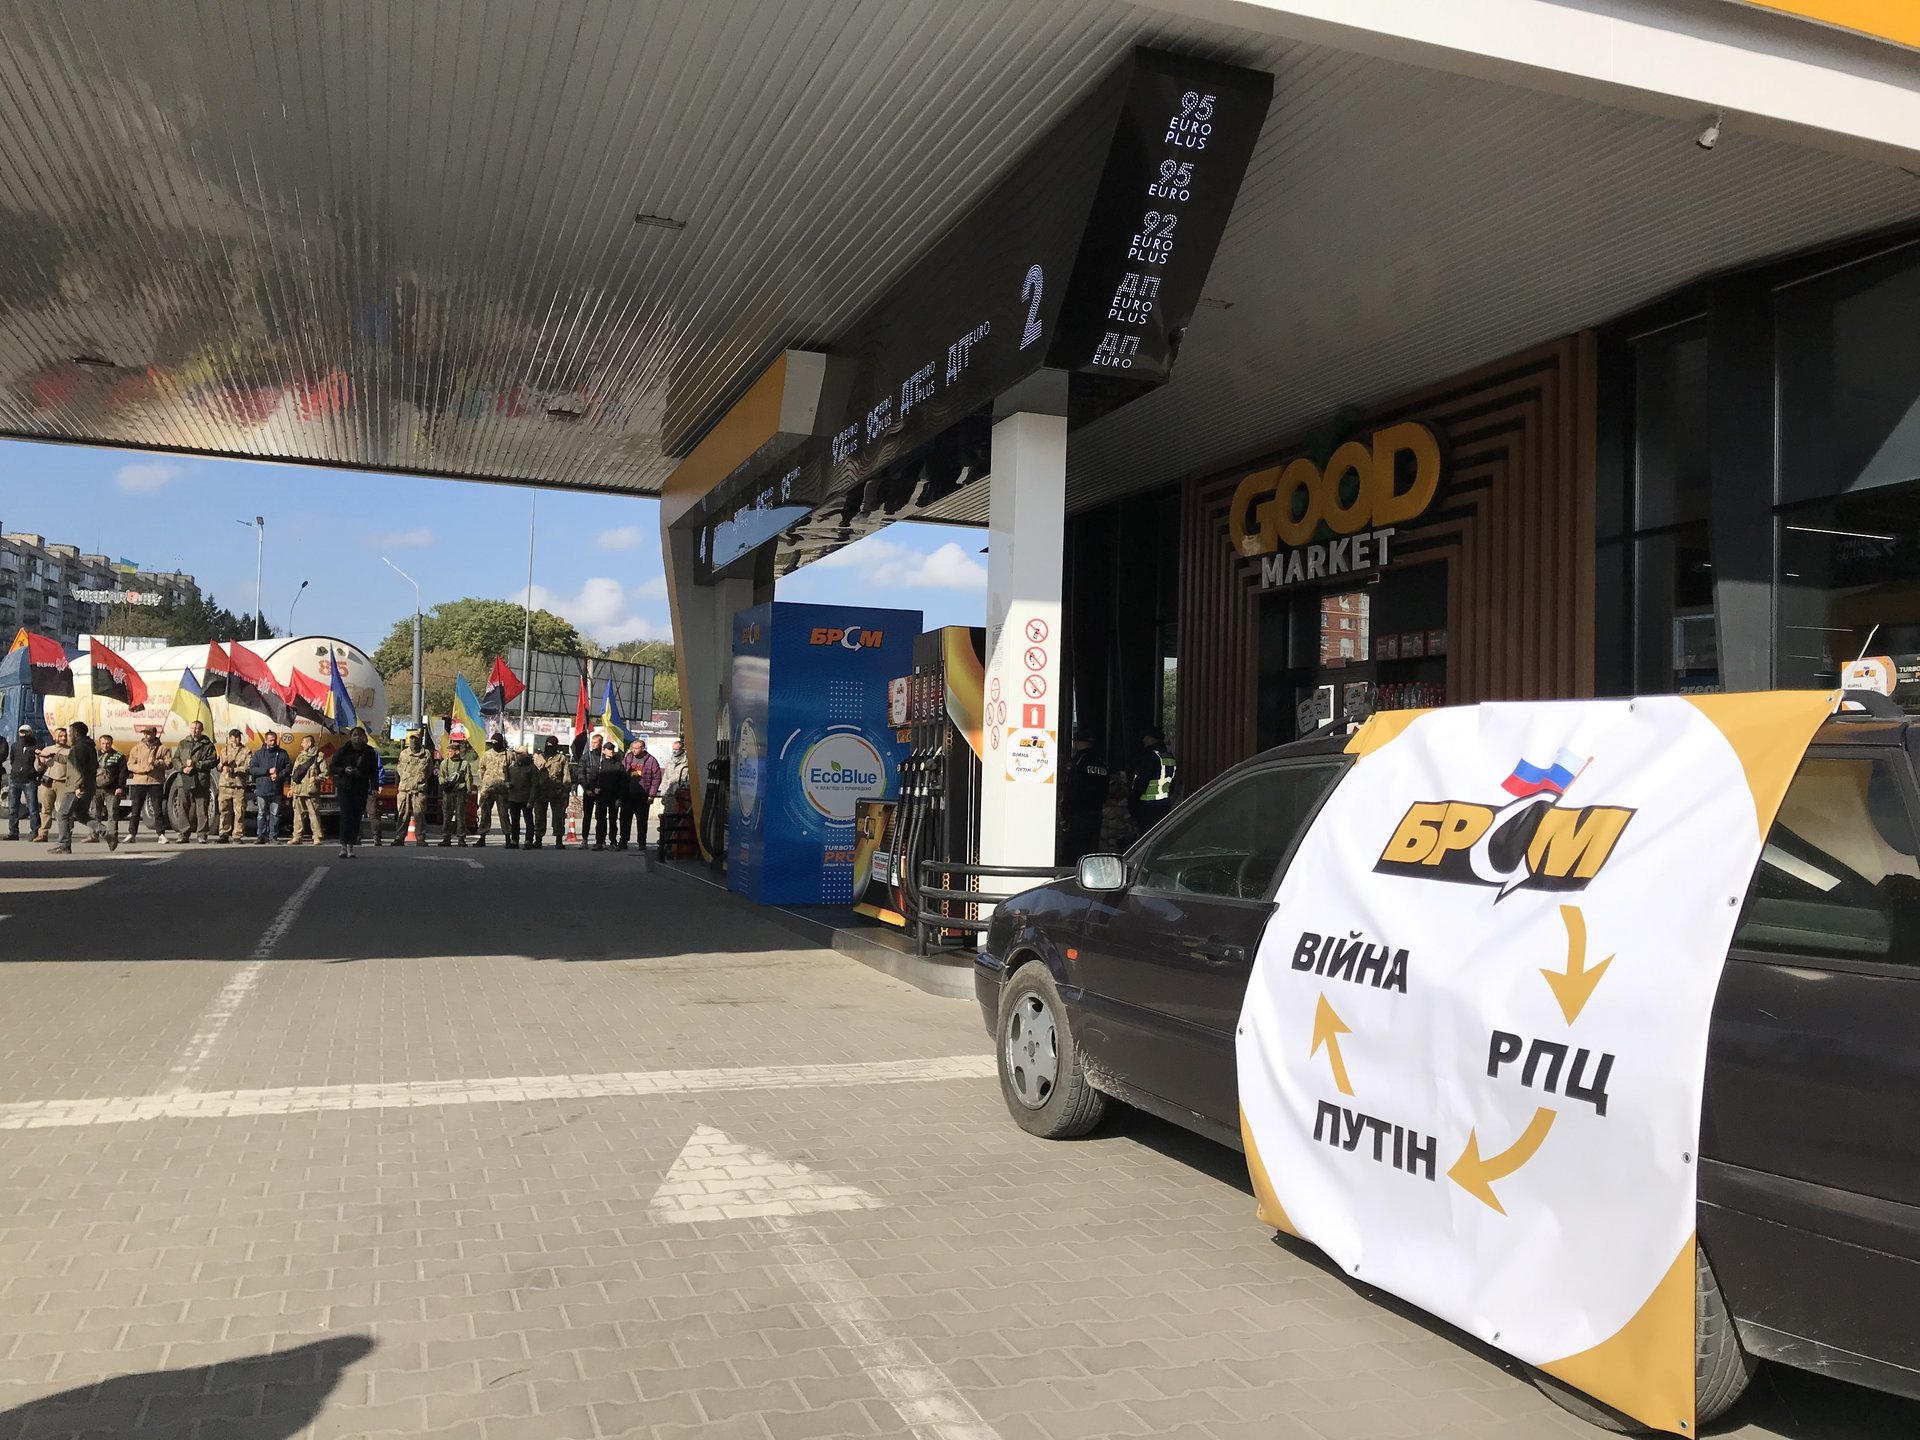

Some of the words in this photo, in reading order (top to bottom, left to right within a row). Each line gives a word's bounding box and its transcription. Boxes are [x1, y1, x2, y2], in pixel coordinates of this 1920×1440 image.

[1180, 90, 1217, 121] 95
[1169, 116, 1212, 136] EURO
[1165, 131, 1206, 150] PLUS
[1158, 158, 1195, 188] 95
[1148, 183, 1190, 202] EURO
[1143, 210, 1178, 239] 92
[1132, 234, 1173, 252] EURO
[1127, 247, 1168, 265] PLUS
[1115, 272, 1162, 299] ДП
[1019, 263, 1043, 351] 2
[1107, 308, 1147, 325] PLUS
[1112, 295, 1153, 313] EURO
[968, 320, 992, 347] EURO
[1096, 331, 1141, 356] ДП
[917, 360, 936, 384] EURO
[1092, 354, 1132, 370] EURO
[918, 380, 935, 403] PLUS
[877, 413, 892, 434] PLUS
[1229, 421, 1441, 557] GOOD
[1261, 528, 1396, 589] MARKET
[809, 625, 884, 652] БРСМ
[318, 659, 349, 678] 85
[810, 768, 877, 785] EcoBlue
[1381, 792, 1633, 895] БРСМ
[1291, 930, 1410, 994] ВІЙНА
[1487, 1030, 1616, 1117] РПЦ
[1313, 1099, 1437, 1182] ПУТІН
